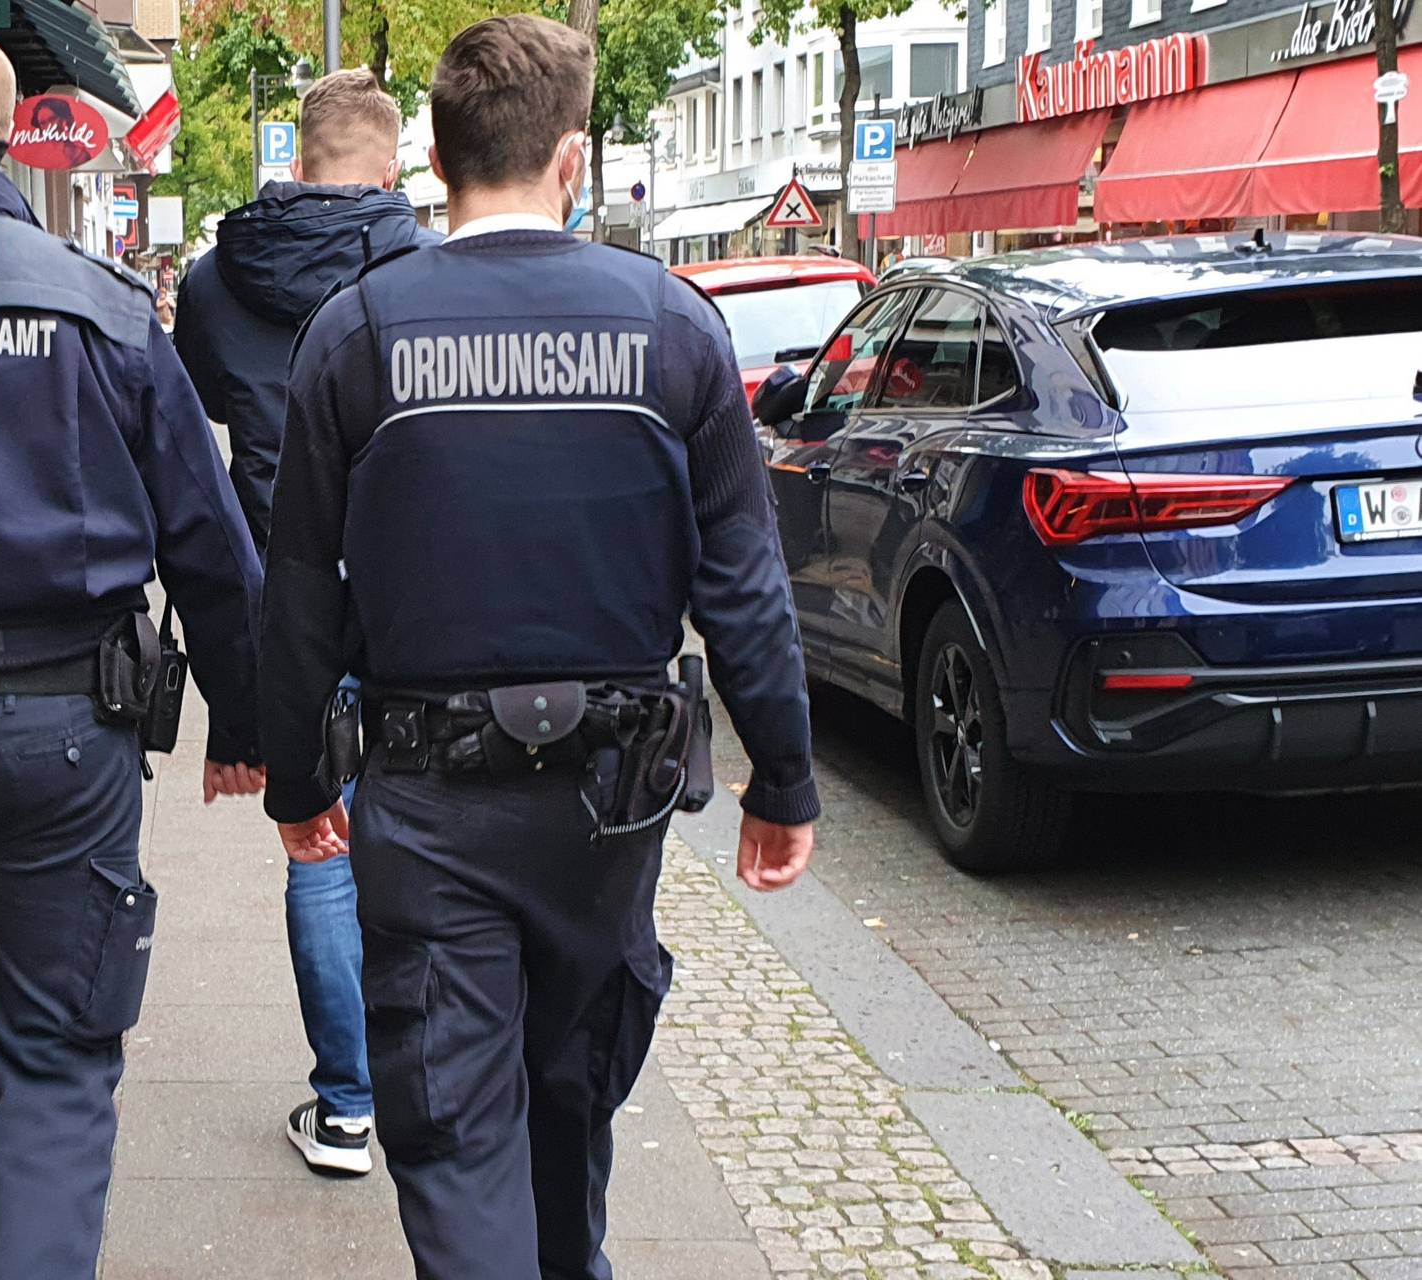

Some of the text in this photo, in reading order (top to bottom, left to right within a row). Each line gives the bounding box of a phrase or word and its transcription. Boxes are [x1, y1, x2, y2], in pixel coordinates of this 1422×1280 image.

[1015, 33, 1193, 123] Kaufmann
[12, 122, 97, 148] mathilde
[269, 127, 287, 160] P
[864, 126, 885, 157] P
[391, 332, 649, 403] ORDNUNGSAMT
[1348, 489, 1386, 525] D W
